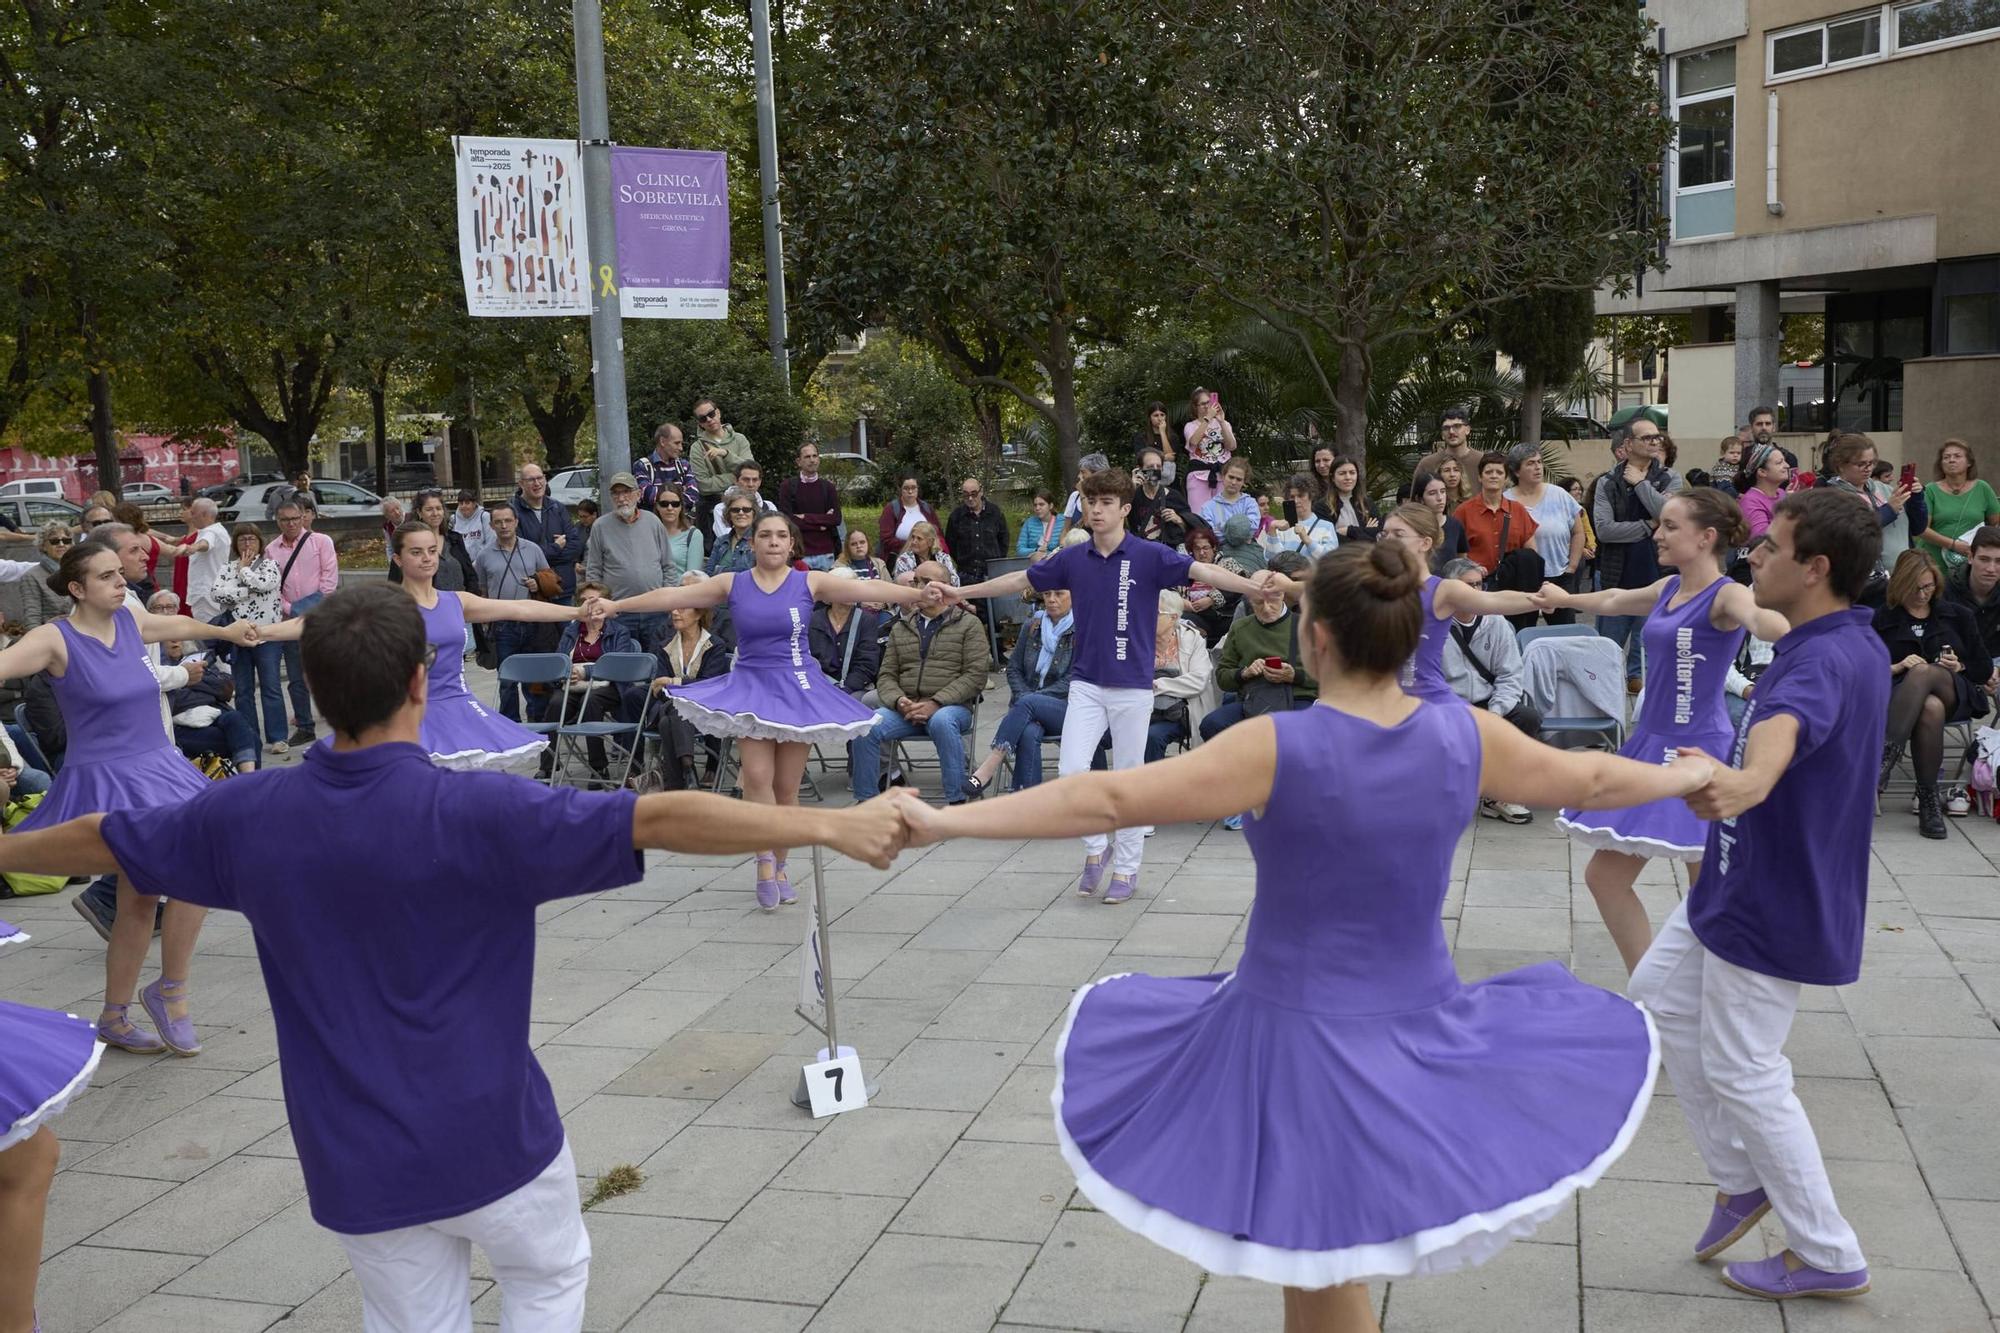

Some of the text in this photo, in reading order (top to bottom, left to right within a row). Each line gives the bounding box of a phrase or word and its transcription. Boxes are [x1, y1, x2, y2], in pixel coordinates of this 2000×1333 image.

[470, 148, 511, 157] temporada
[637, 173, 701, 188] CLINICA
[620, 184, 722, 205] SOBREVIELA
[633, 295, 668, 304] temporada
[1115, 636, 1129, 661] jove
[824, 1067, 844, 1102] 7
